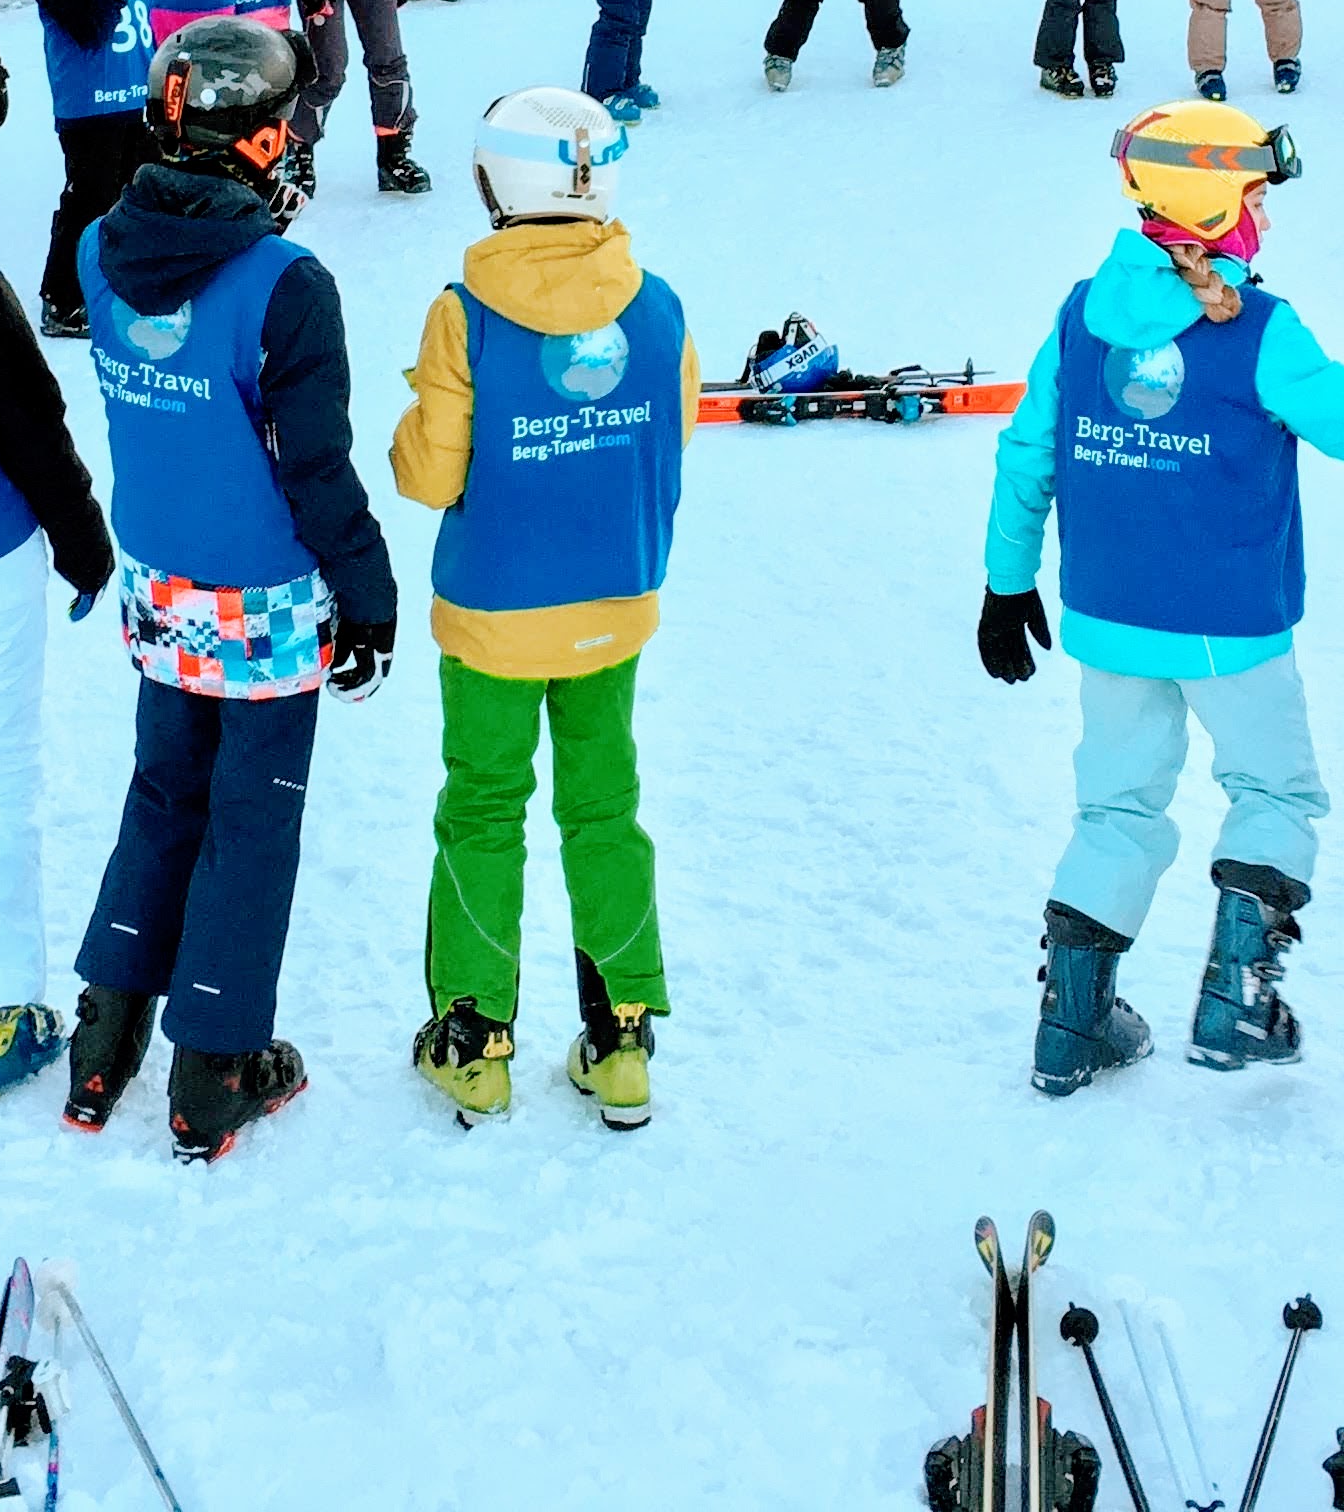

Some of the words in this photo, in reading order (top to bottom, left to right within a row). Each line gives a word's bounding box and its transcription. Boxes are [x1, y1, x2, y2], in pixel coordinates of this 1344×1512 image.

[111, 0, 153, 53] 38
[94, 348, 212, 400] Berg-Travel
[785, 343, 819, 370] uvex
[512, 400, 652, 439] Berg-Travel
[1075, 416, 1212, 456] Berg-Travel
[512, 433, 631, 462] Berg-Travel.com
[1074, 444, 1181, 473] Berg-Travel.com
